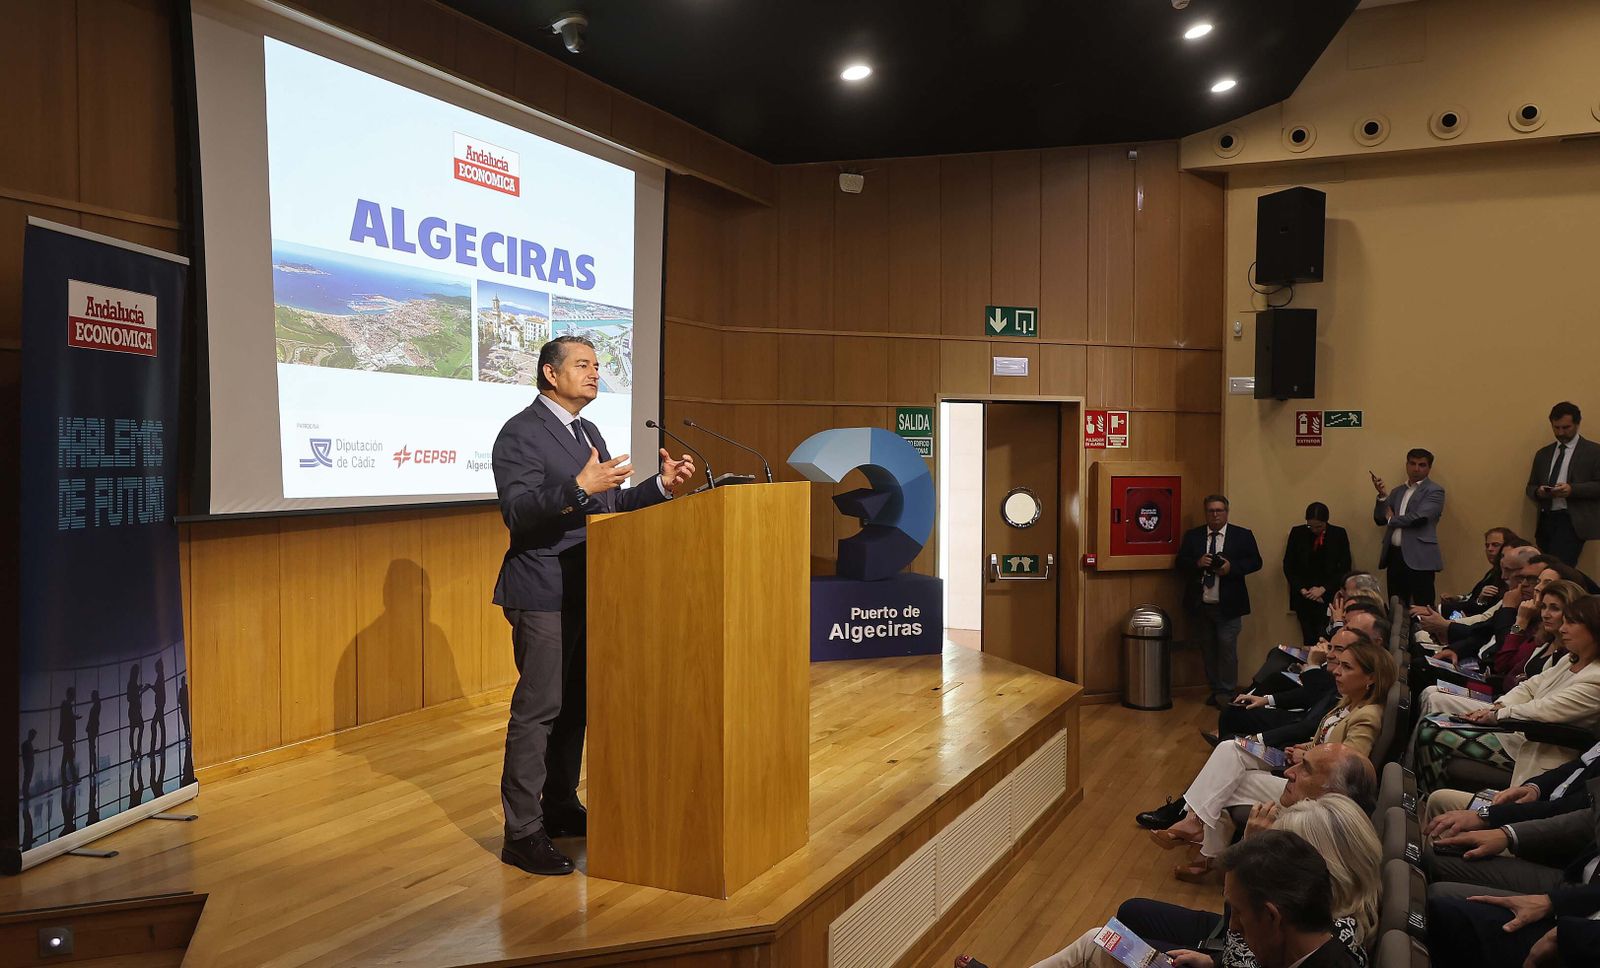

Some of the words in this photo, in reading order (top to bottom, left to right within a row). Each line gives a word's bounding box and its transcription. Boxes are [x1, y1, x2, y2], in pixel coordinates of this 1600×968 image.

[465, 145, 509, 172] Andalucía
[458, 162, 516, 192] ECONOMICA
[349, 198, 597, 291] ALGECIRAS
[85, 296, 145, 325] Andalucía
[75, 321, 153, 350] ECONOMICA
[898, 413, 930, 431] SALIDA
[336, 439, 383, 452] Diputación
[413, 449, 457, 464] CEPSA
[336, 456, 348, 468] de
[351, 456, 375, 468] Cádiz
[58, 478, 86, 530] DE
[850, 606, 898, 621] Puerto
[902, 604, 920, 618] de
[828, 620, 923, 643] Algeciras
